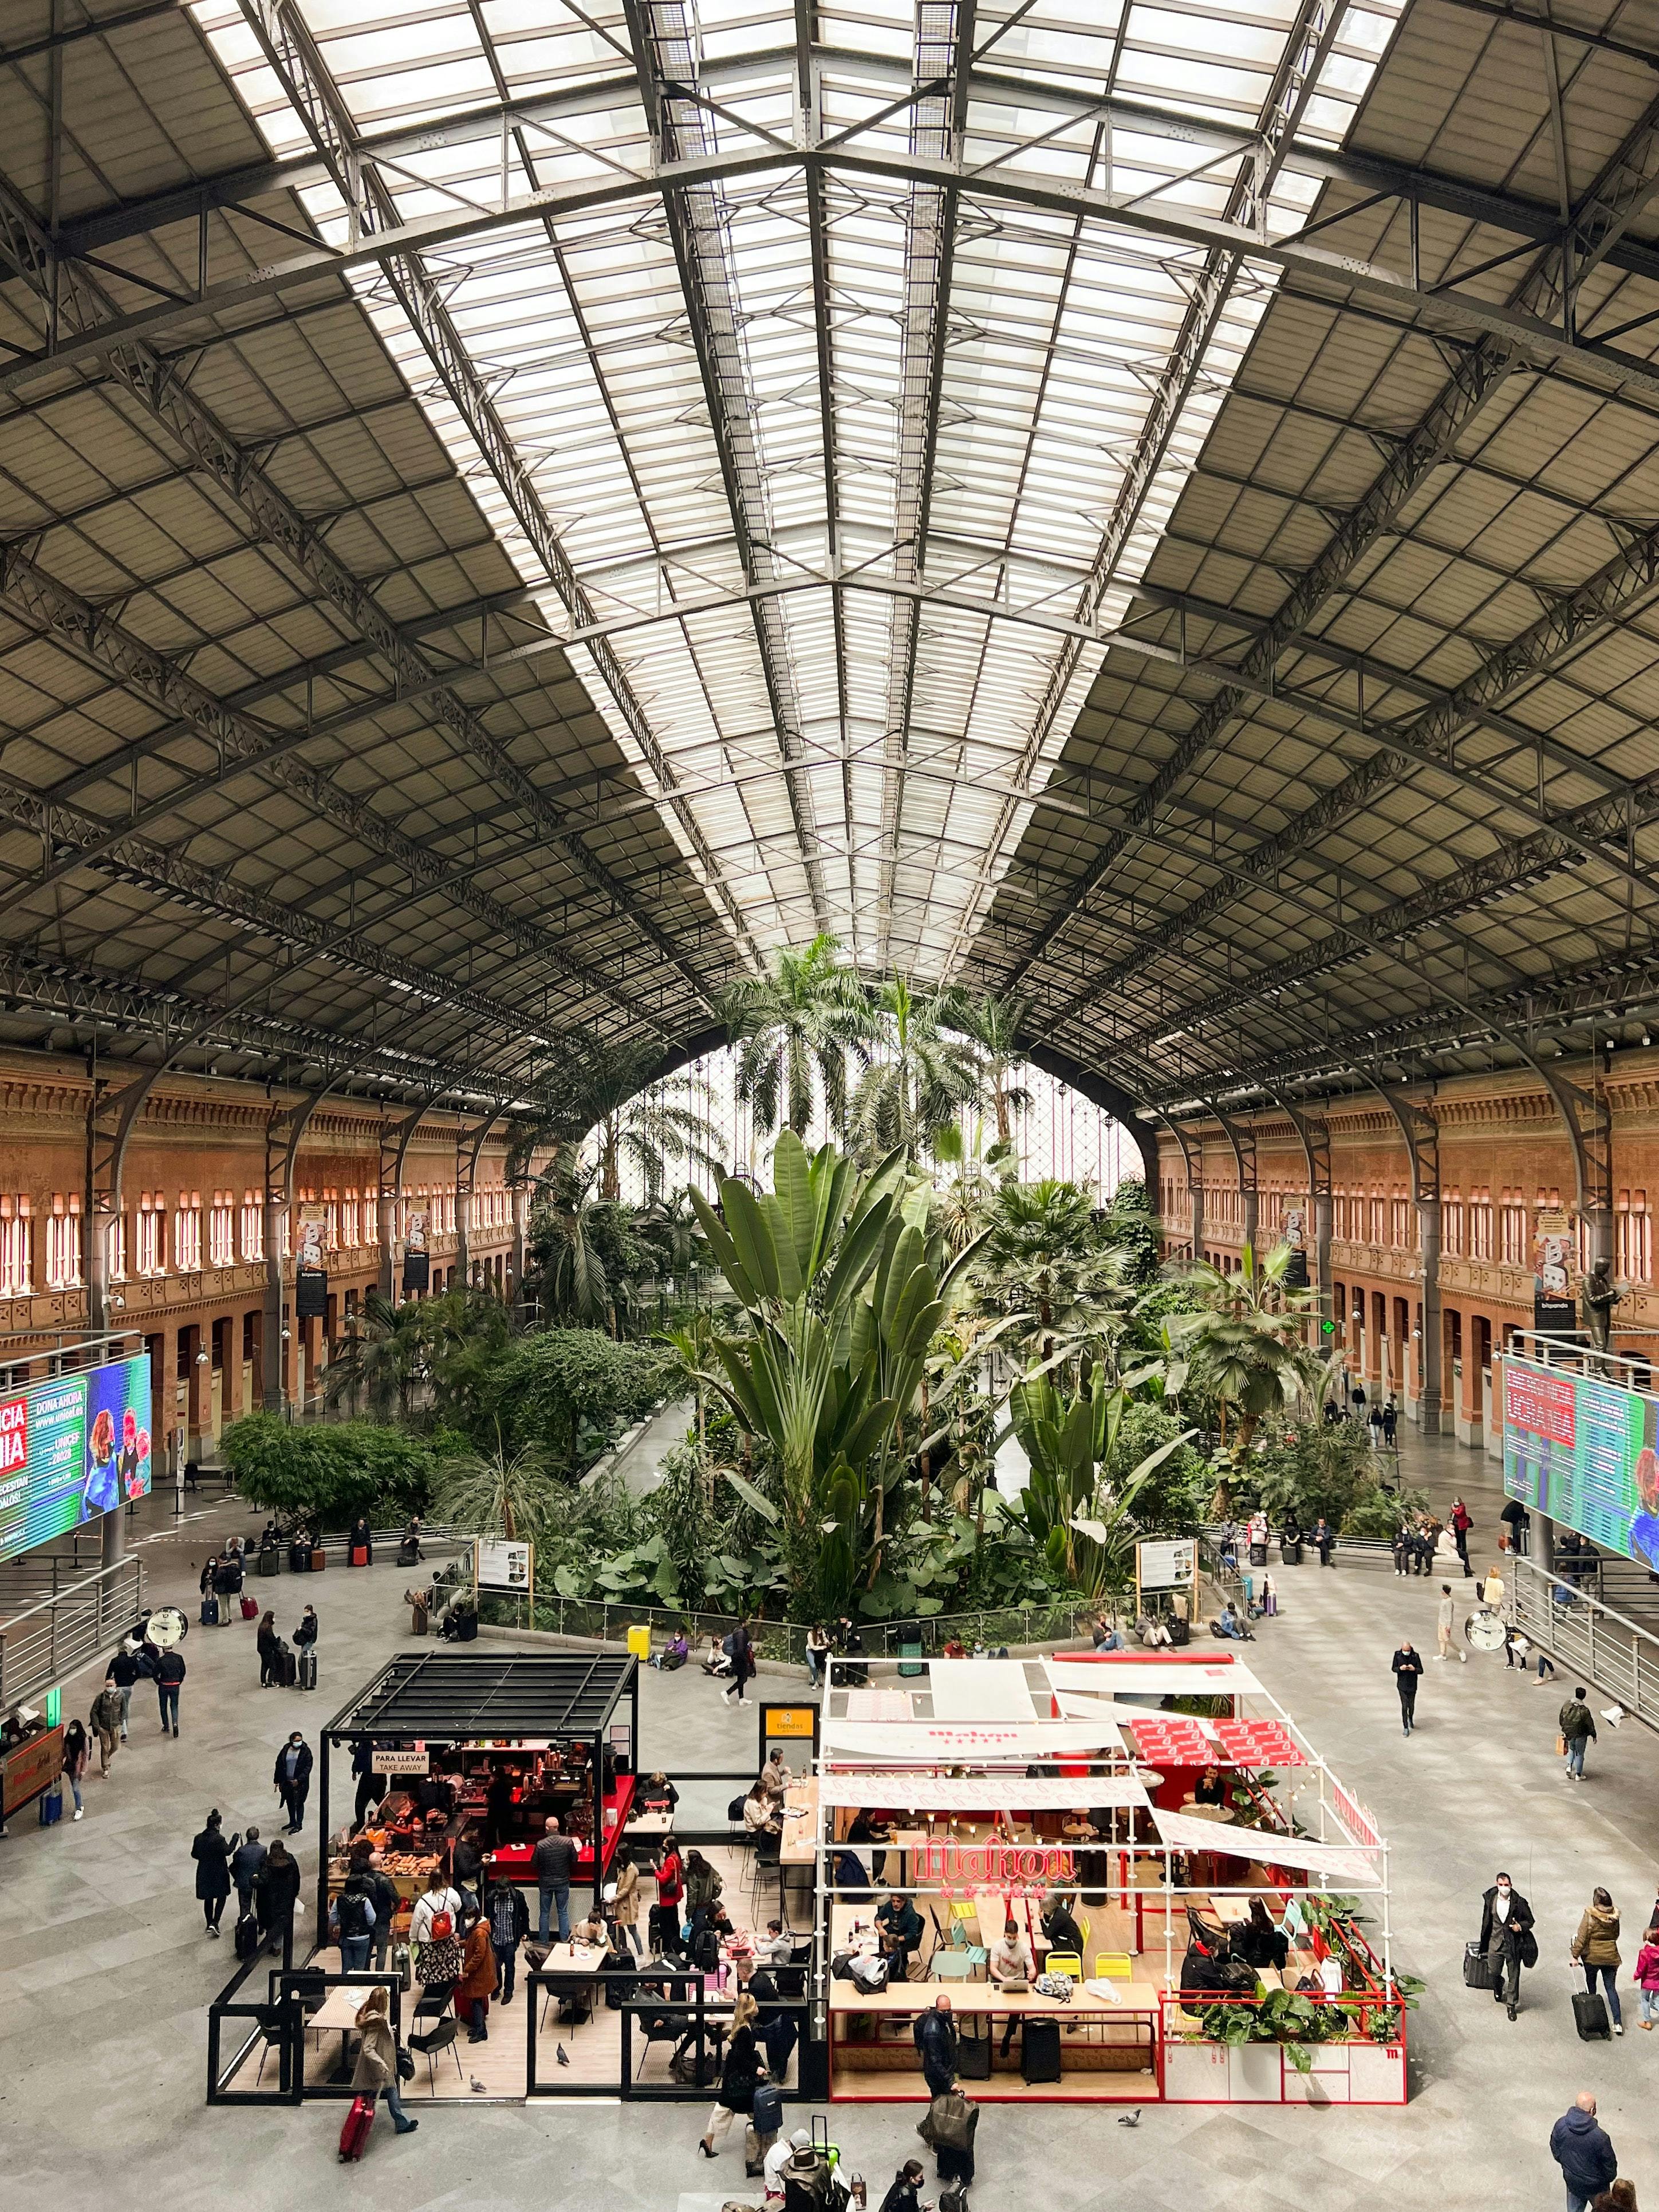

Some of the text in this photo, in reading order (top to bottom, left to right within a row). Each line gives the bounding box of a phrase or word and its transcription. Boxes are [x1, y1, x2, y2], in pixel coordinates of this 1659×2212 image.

[36, 1390, 83, 1415] DONA AHORA
[0, 1404, 25, 1431] CIA
[0, 1432, 25, 1469] IA
[54, 1432, 80, 1450] UNICEF
